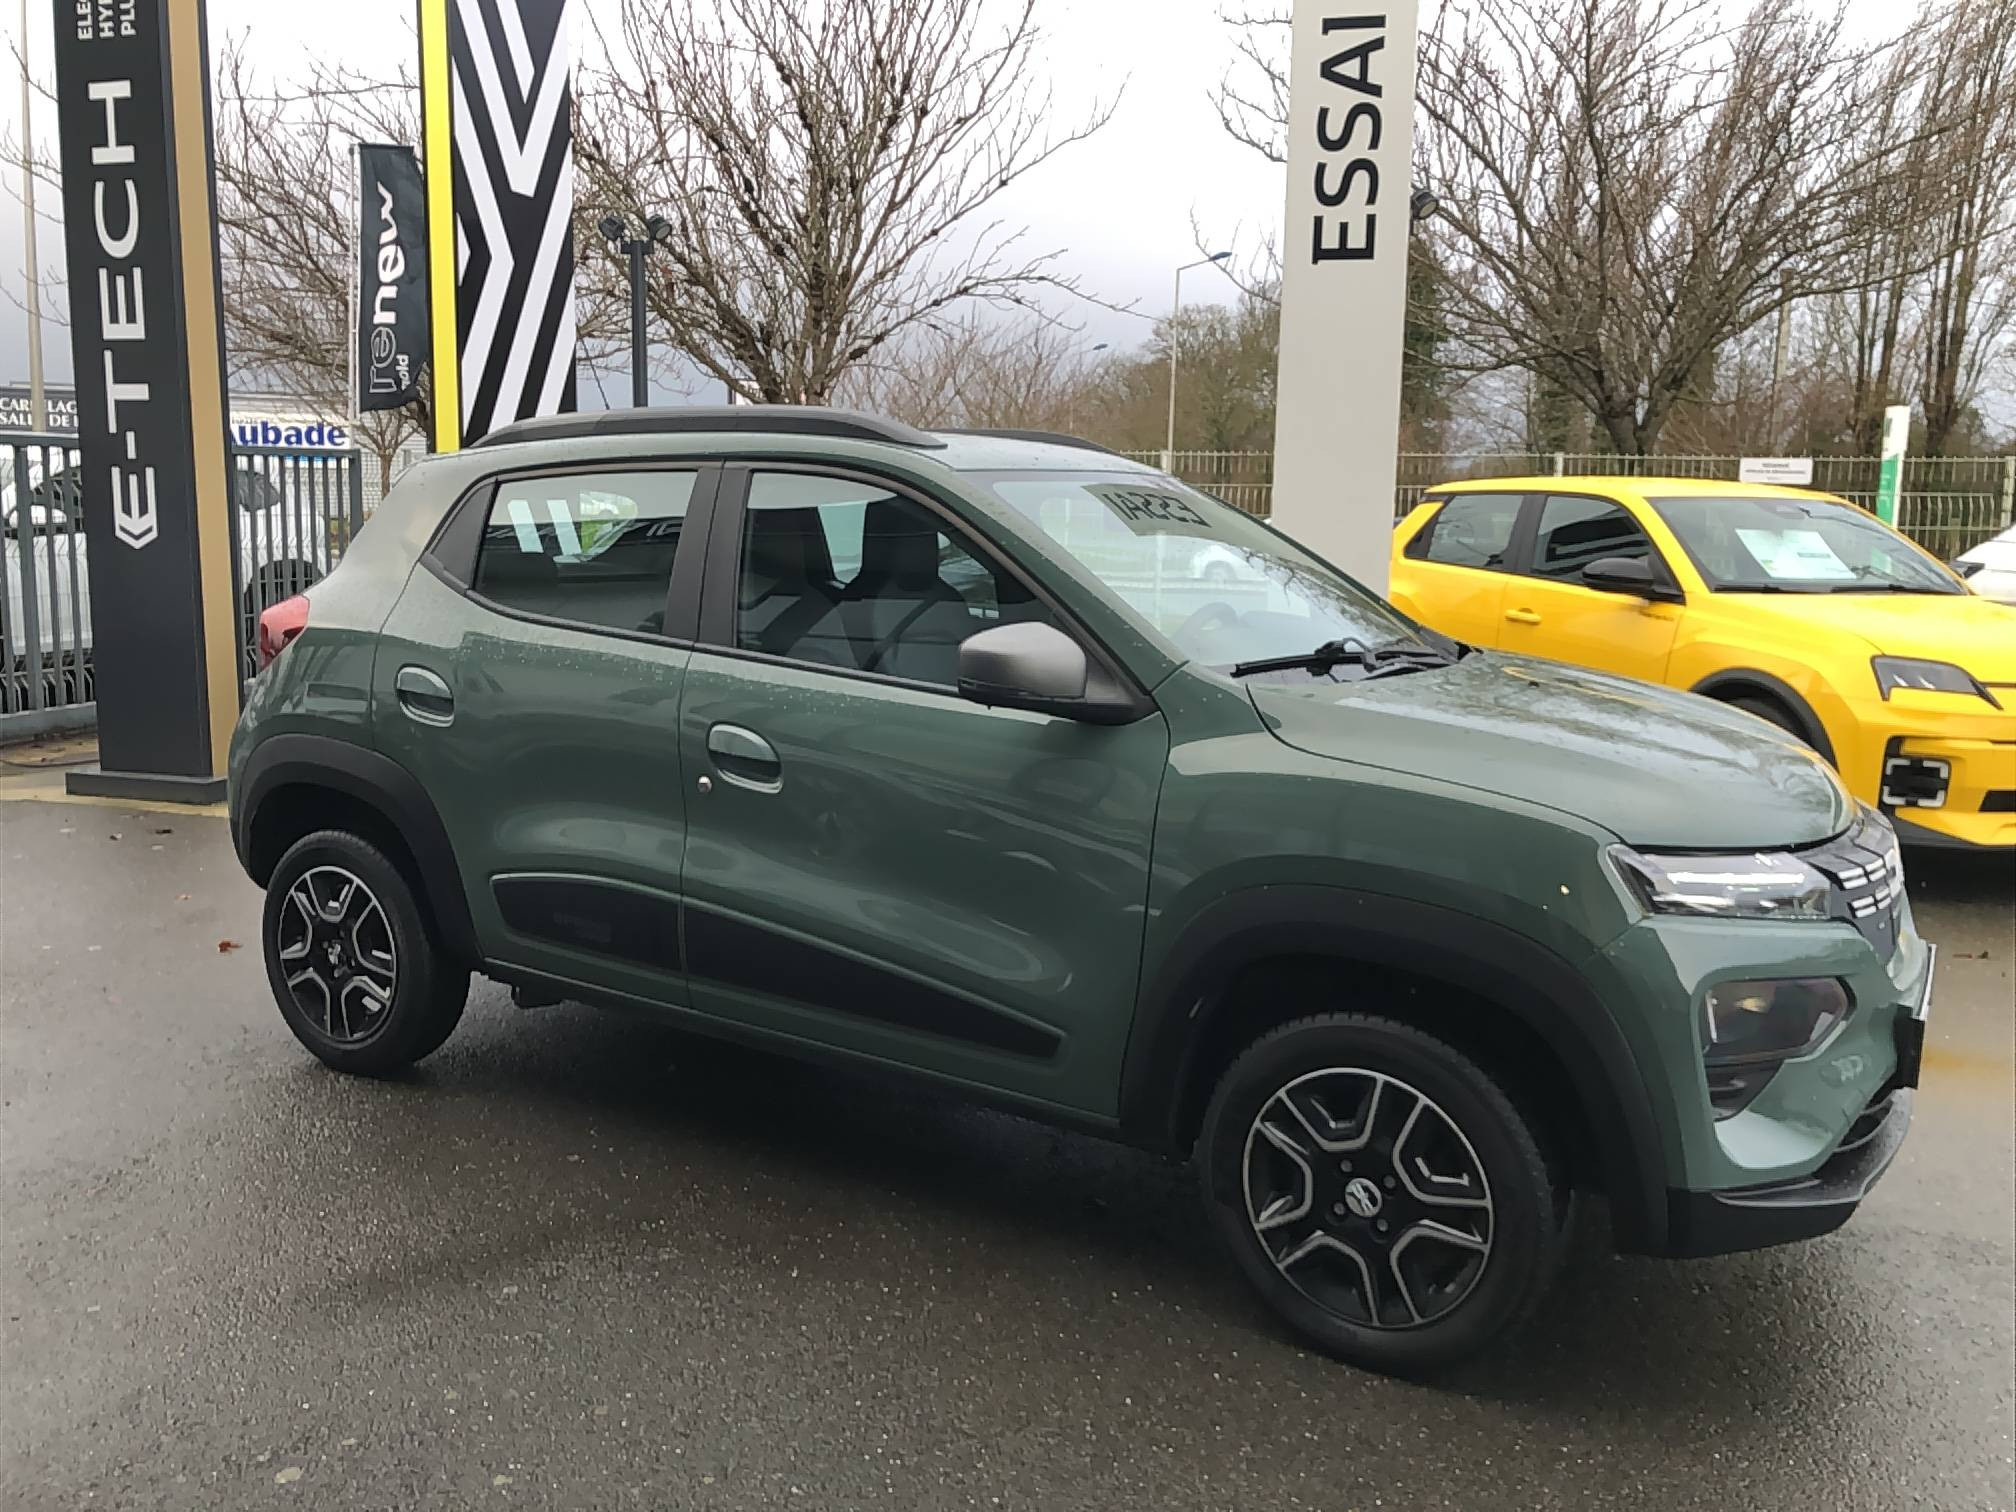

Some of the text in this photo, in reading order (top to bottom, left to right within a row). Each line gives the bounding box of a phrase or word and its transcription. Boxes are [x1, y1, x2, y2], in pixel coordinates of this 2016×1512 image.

[76, 0, 93, 40] ELE
[1311, 14, 1387, 265] ESSAI
[88, 79, 158, 550] E-TECH
[369, 180, 405, 394] renew
[231, 419, 348, 447] ubade
